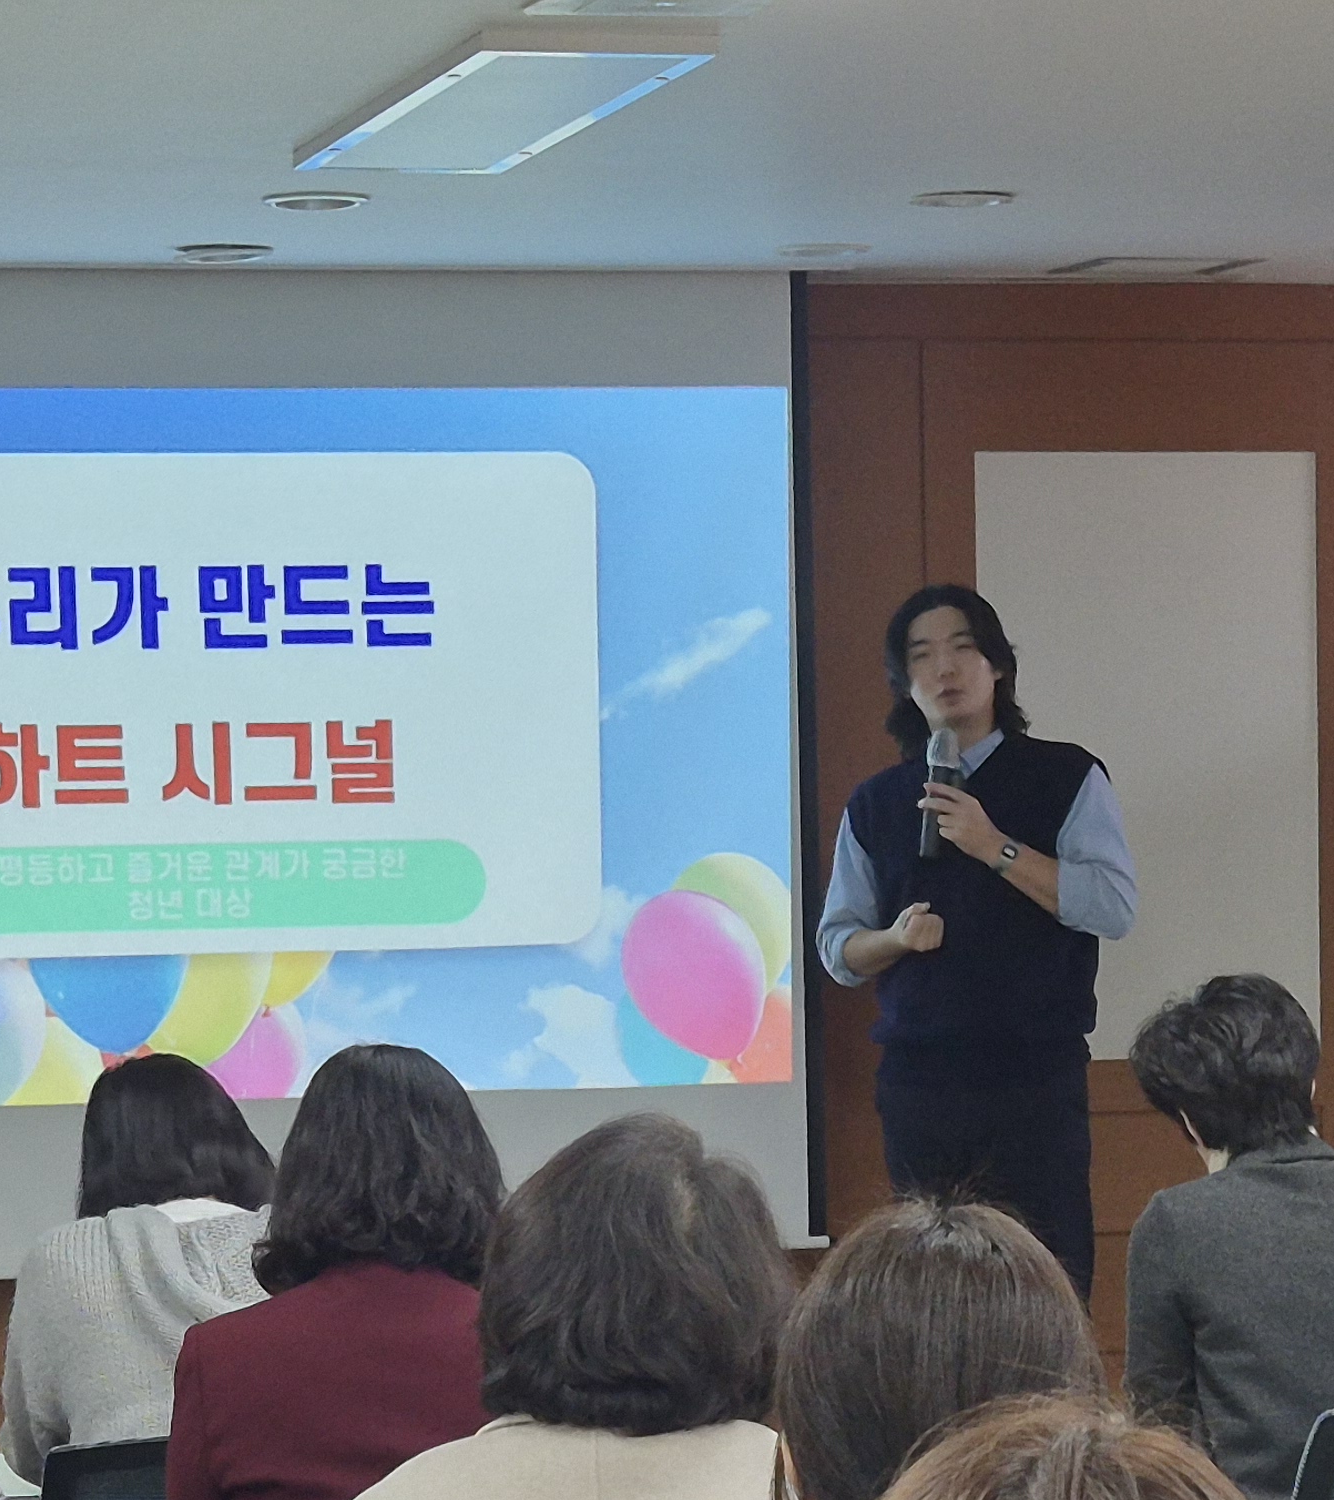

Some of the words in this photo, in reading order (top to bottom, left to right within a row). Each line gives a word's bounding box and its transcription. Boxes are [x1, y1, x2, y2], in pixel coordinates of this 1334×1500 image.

[198, 563, 435, 649] 만드는
[162, 720, 394, 804] 시그널
[127, 850, 213, 884] 즐거운
[225, 849, 311, 882] 관계가
[322, 847, 407, 881] 궁금한
[128, 889, 184, 921] 청년
[196, 887, 254, 919] 대상
